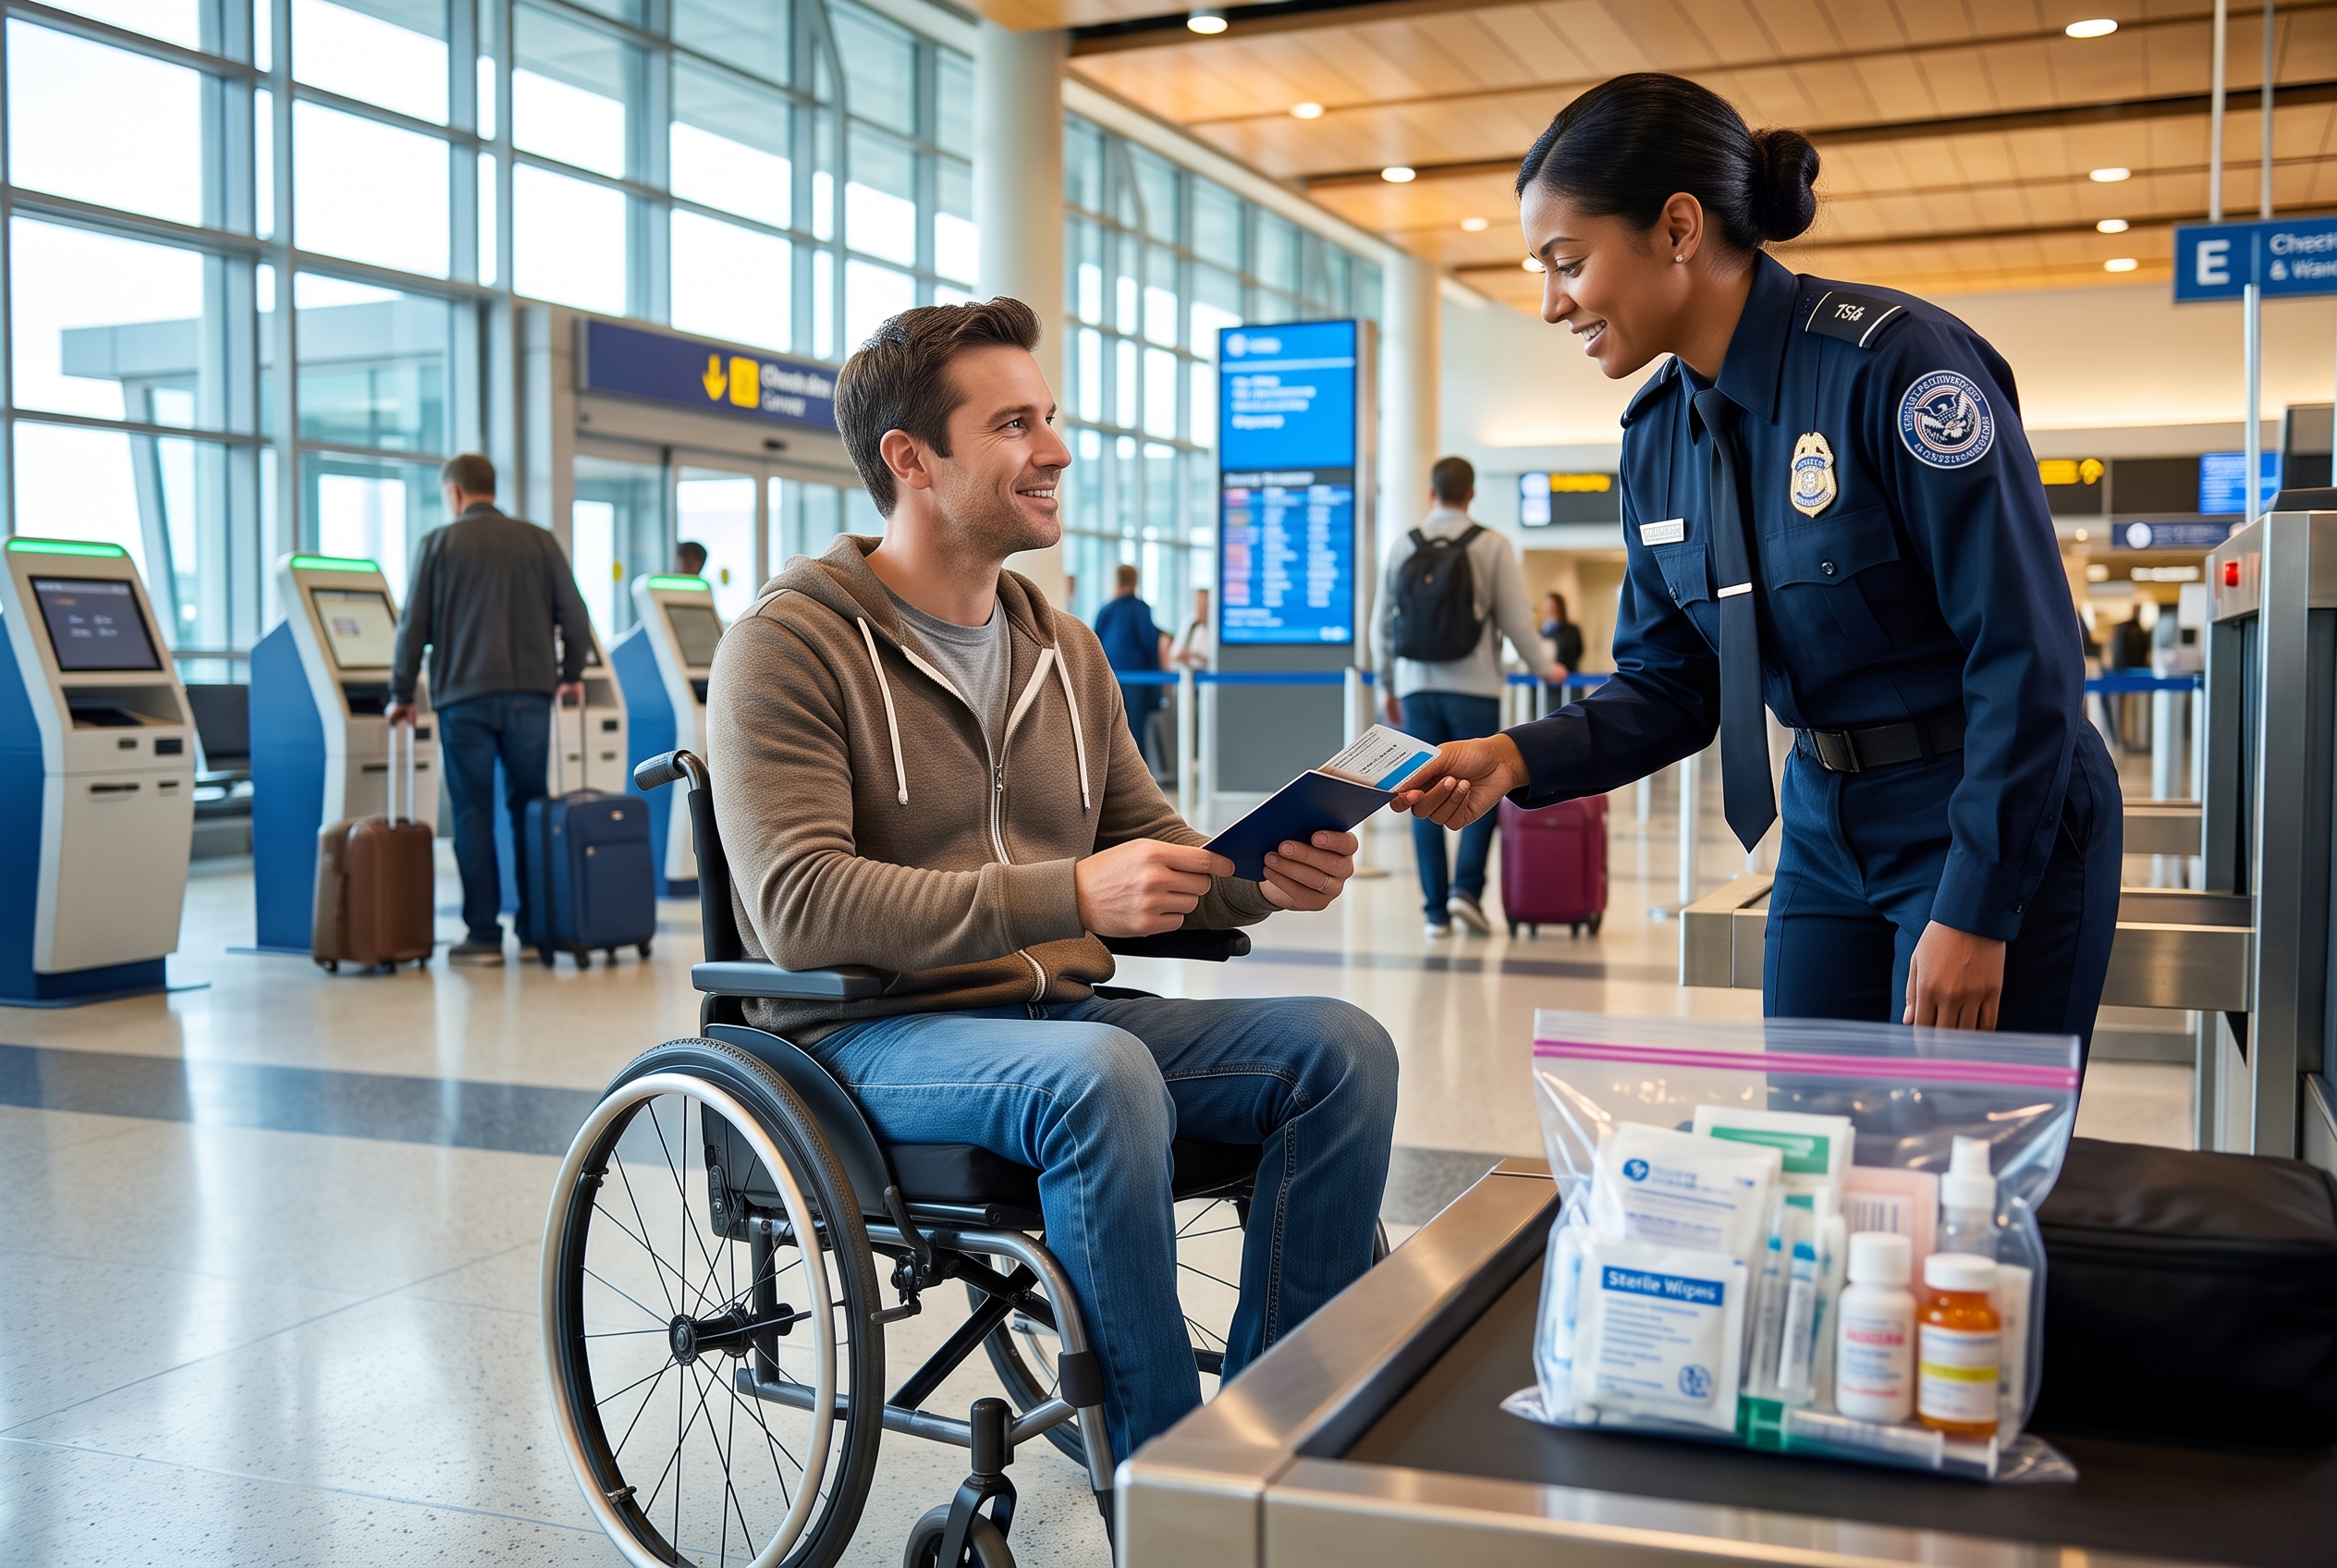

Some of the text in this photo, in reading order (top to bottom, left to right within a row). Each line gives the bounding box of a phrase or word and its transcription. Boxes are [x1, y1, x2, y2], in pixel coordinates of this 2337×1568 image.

[2196, 239, 2231, 287] E
[2269, 259, 2289, 281] &
[1609, 1270, 1661, 1292] Sterile
